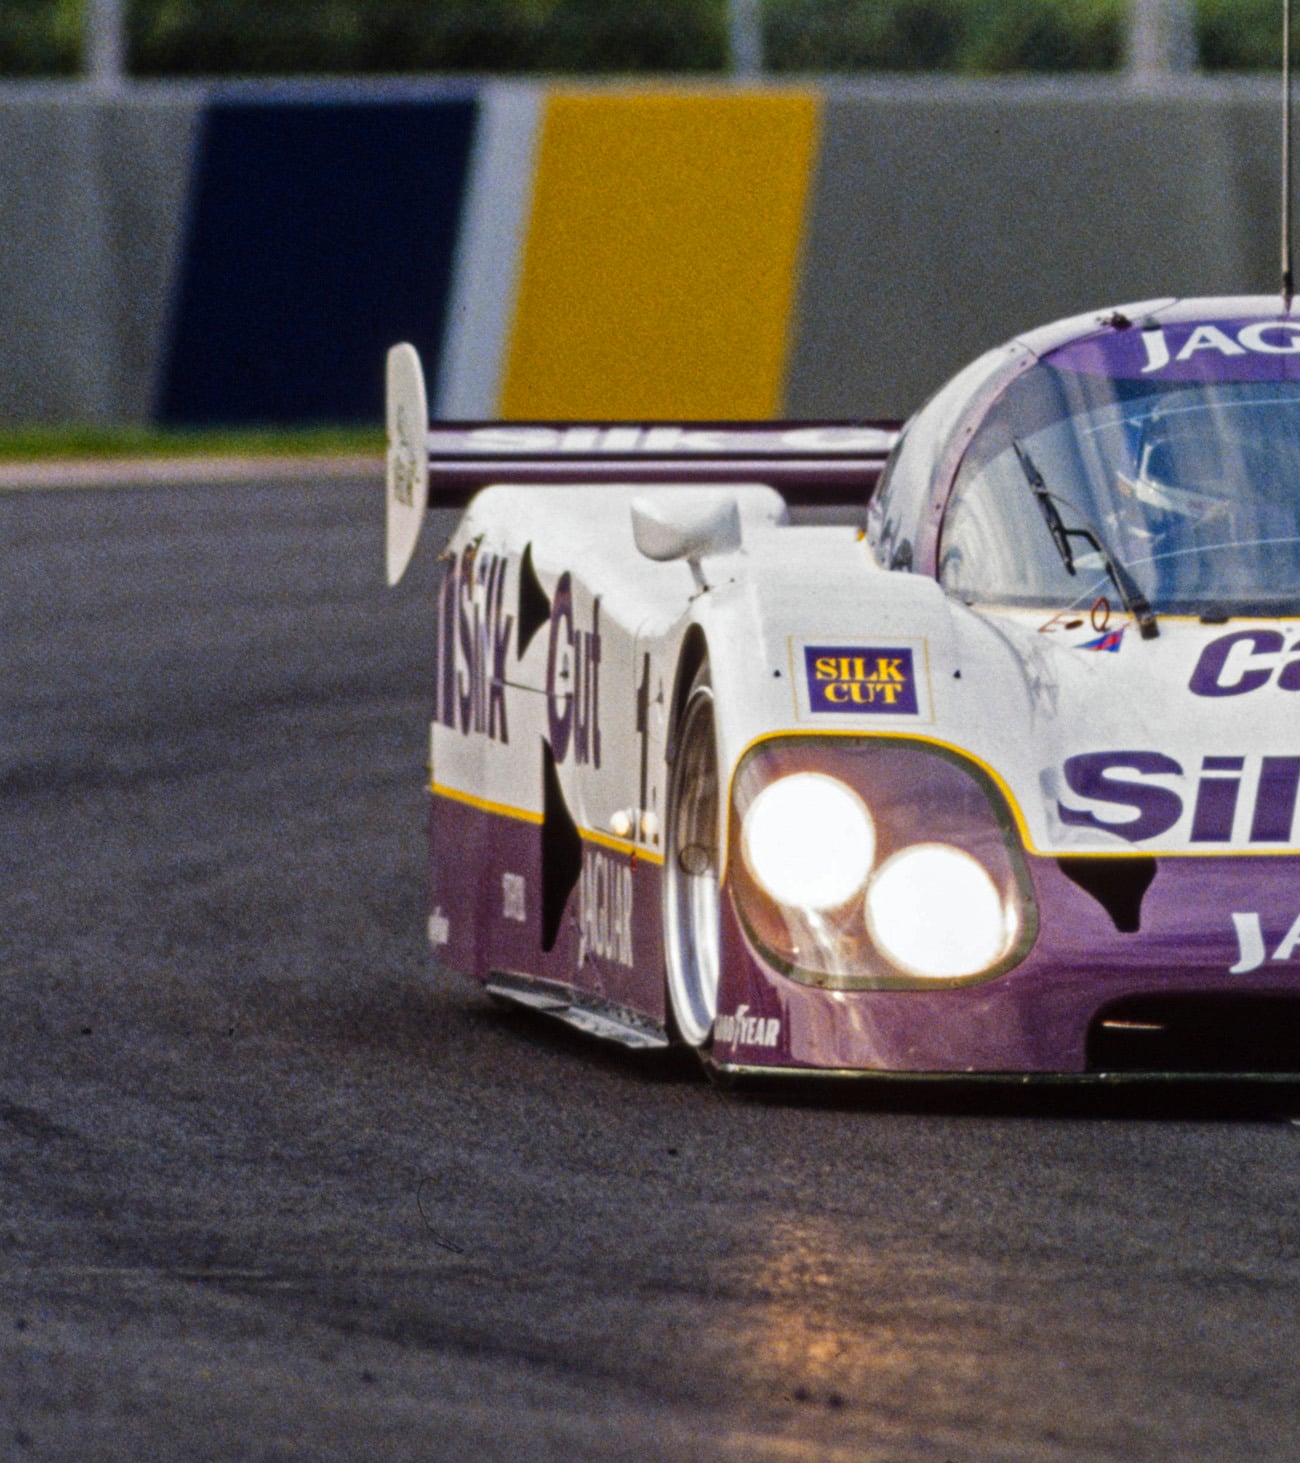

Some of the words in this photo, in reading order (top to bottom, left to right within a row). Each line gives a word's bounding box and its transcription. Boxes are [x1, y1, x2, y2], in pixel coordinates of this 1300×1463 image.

[545, 570, 602, 770] Cut
[814, 656, 906, 682] SILK
[823, 682, 904, 705] CUT
